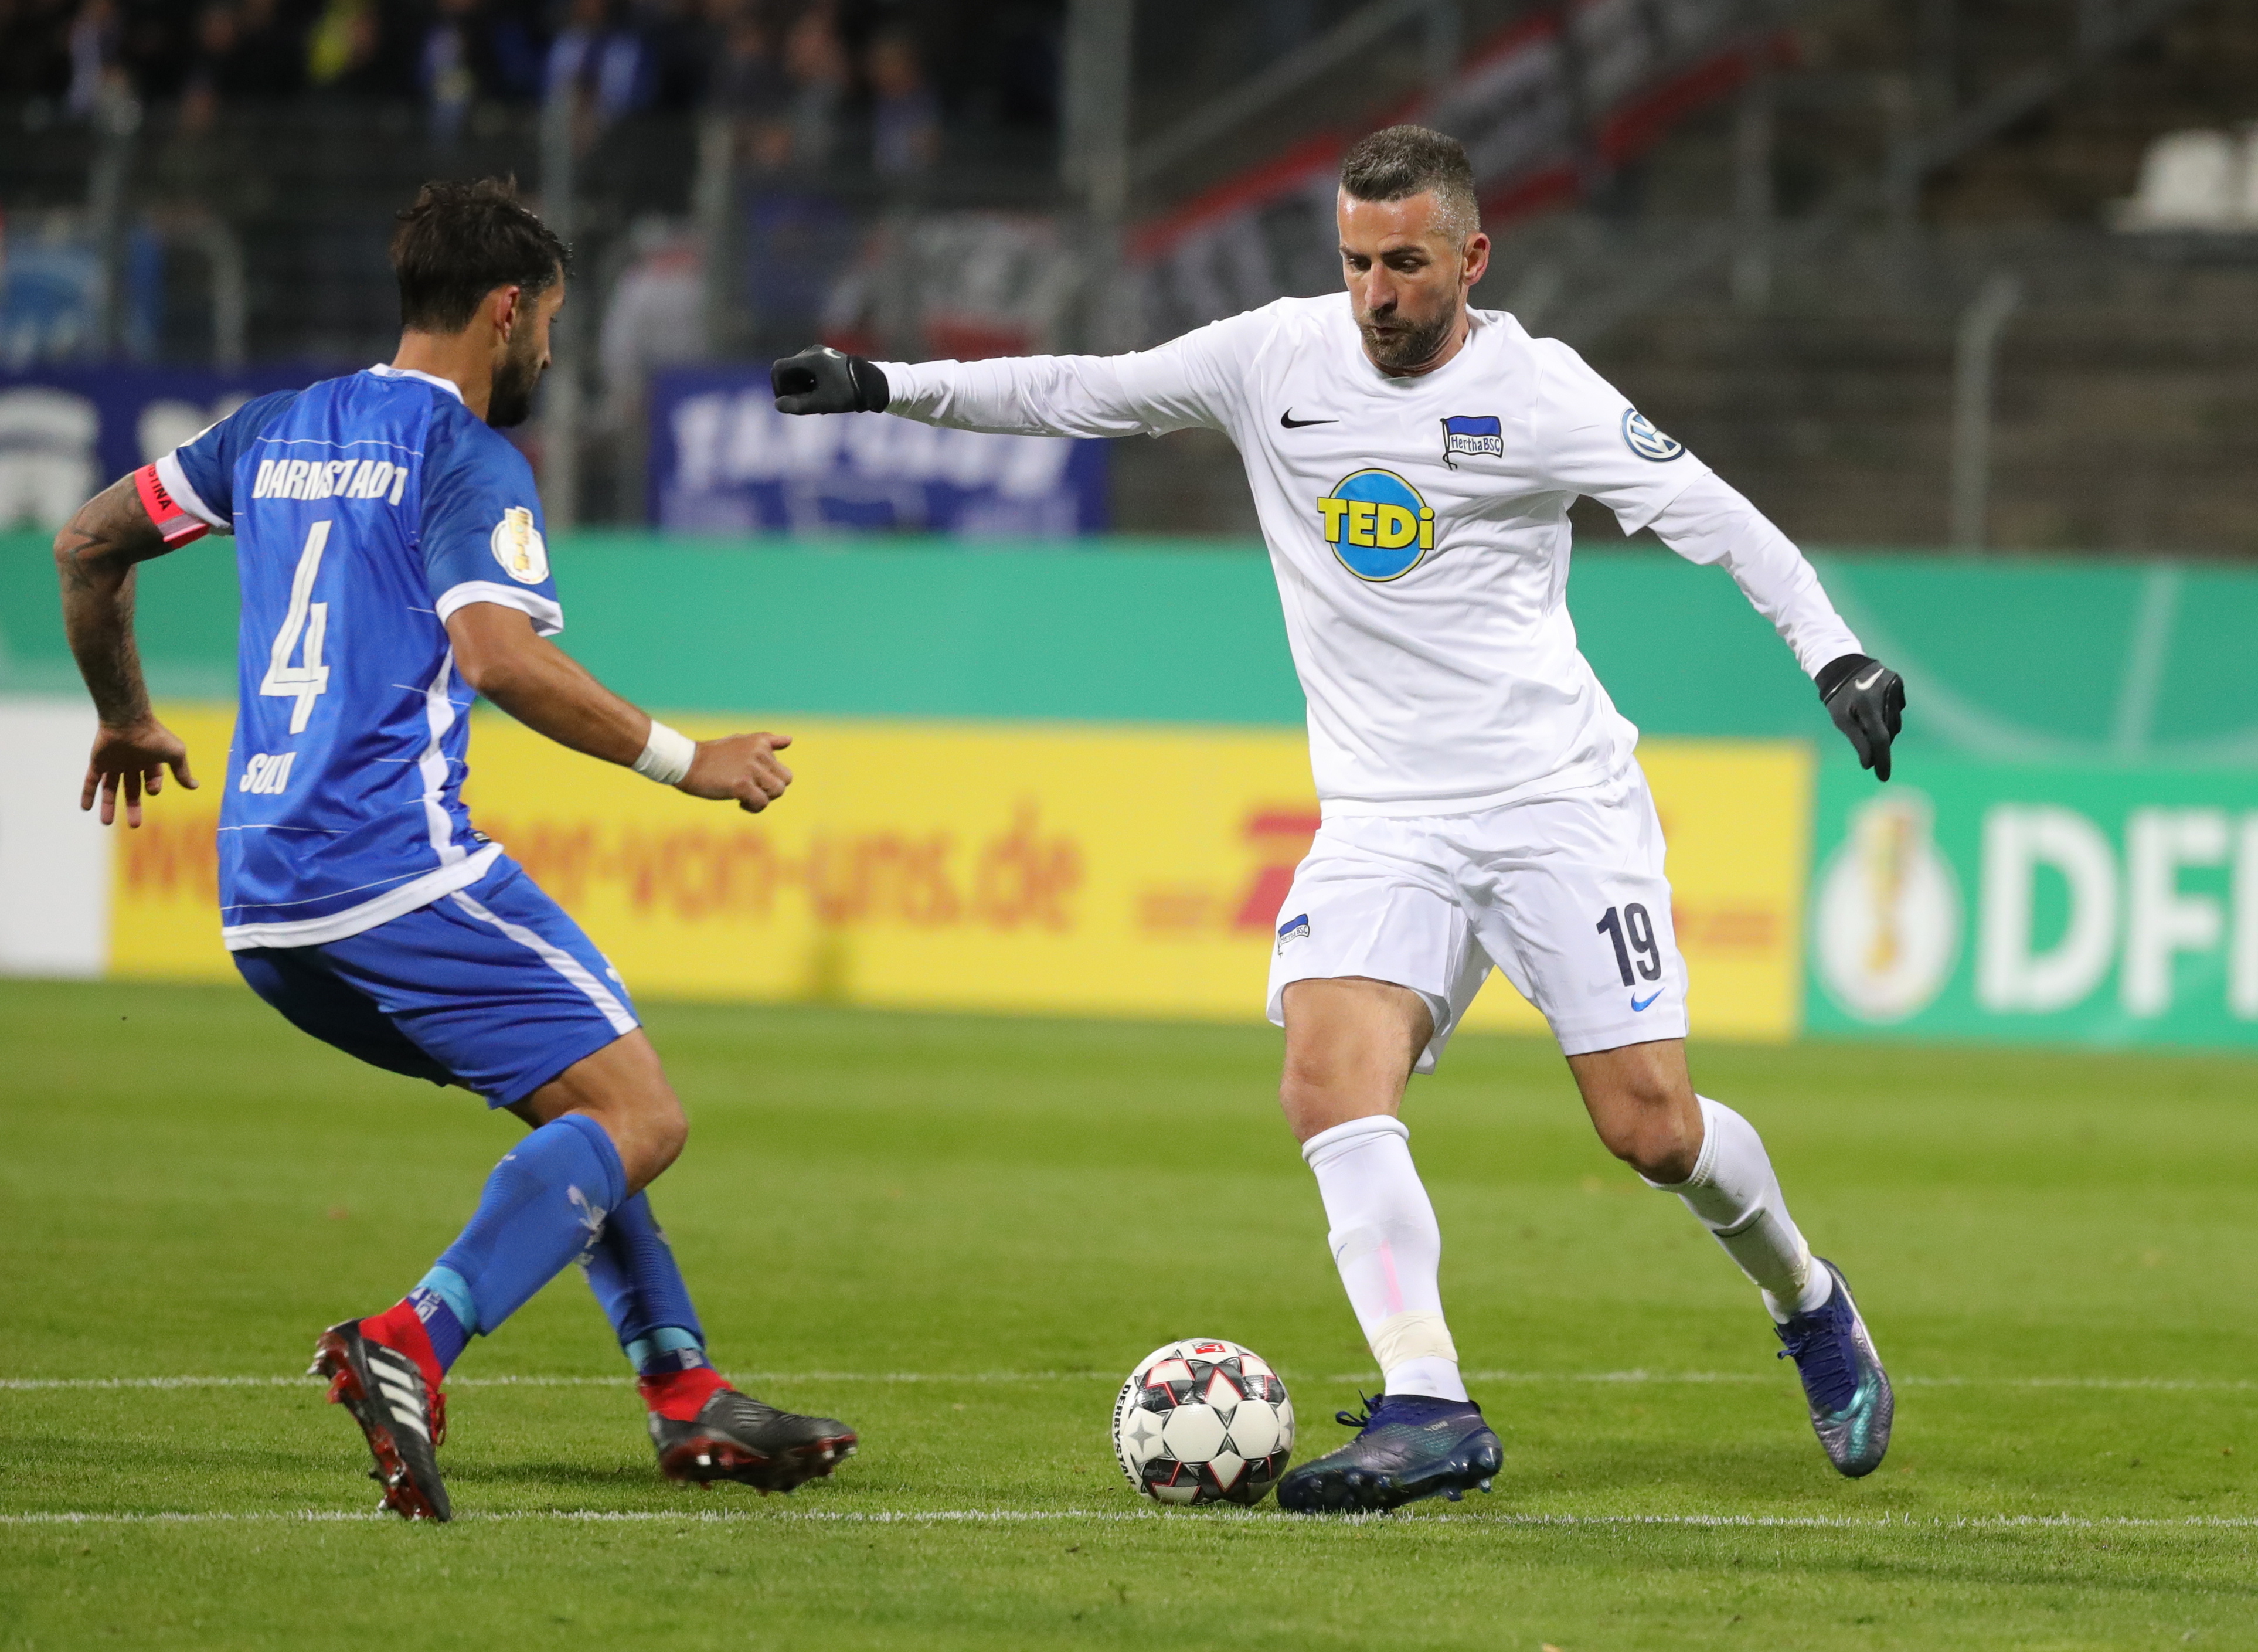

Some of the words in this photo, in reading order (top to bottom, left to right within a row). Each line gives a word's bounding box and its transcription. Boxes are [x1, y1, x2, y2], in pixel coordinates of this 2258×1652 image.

[1451, 436, 1483, 452] Hertha
[1483, 437, 1501, 453] BSC
[251, 459, 409, 506] DARMSTADT
[1317, 497, 1435, 550] TEDi
[259, 520, 332, 735] 4
[1596, 903, 1661, 987] 19
[1114, 1384, 1136, 1485] DERBYSTAR
